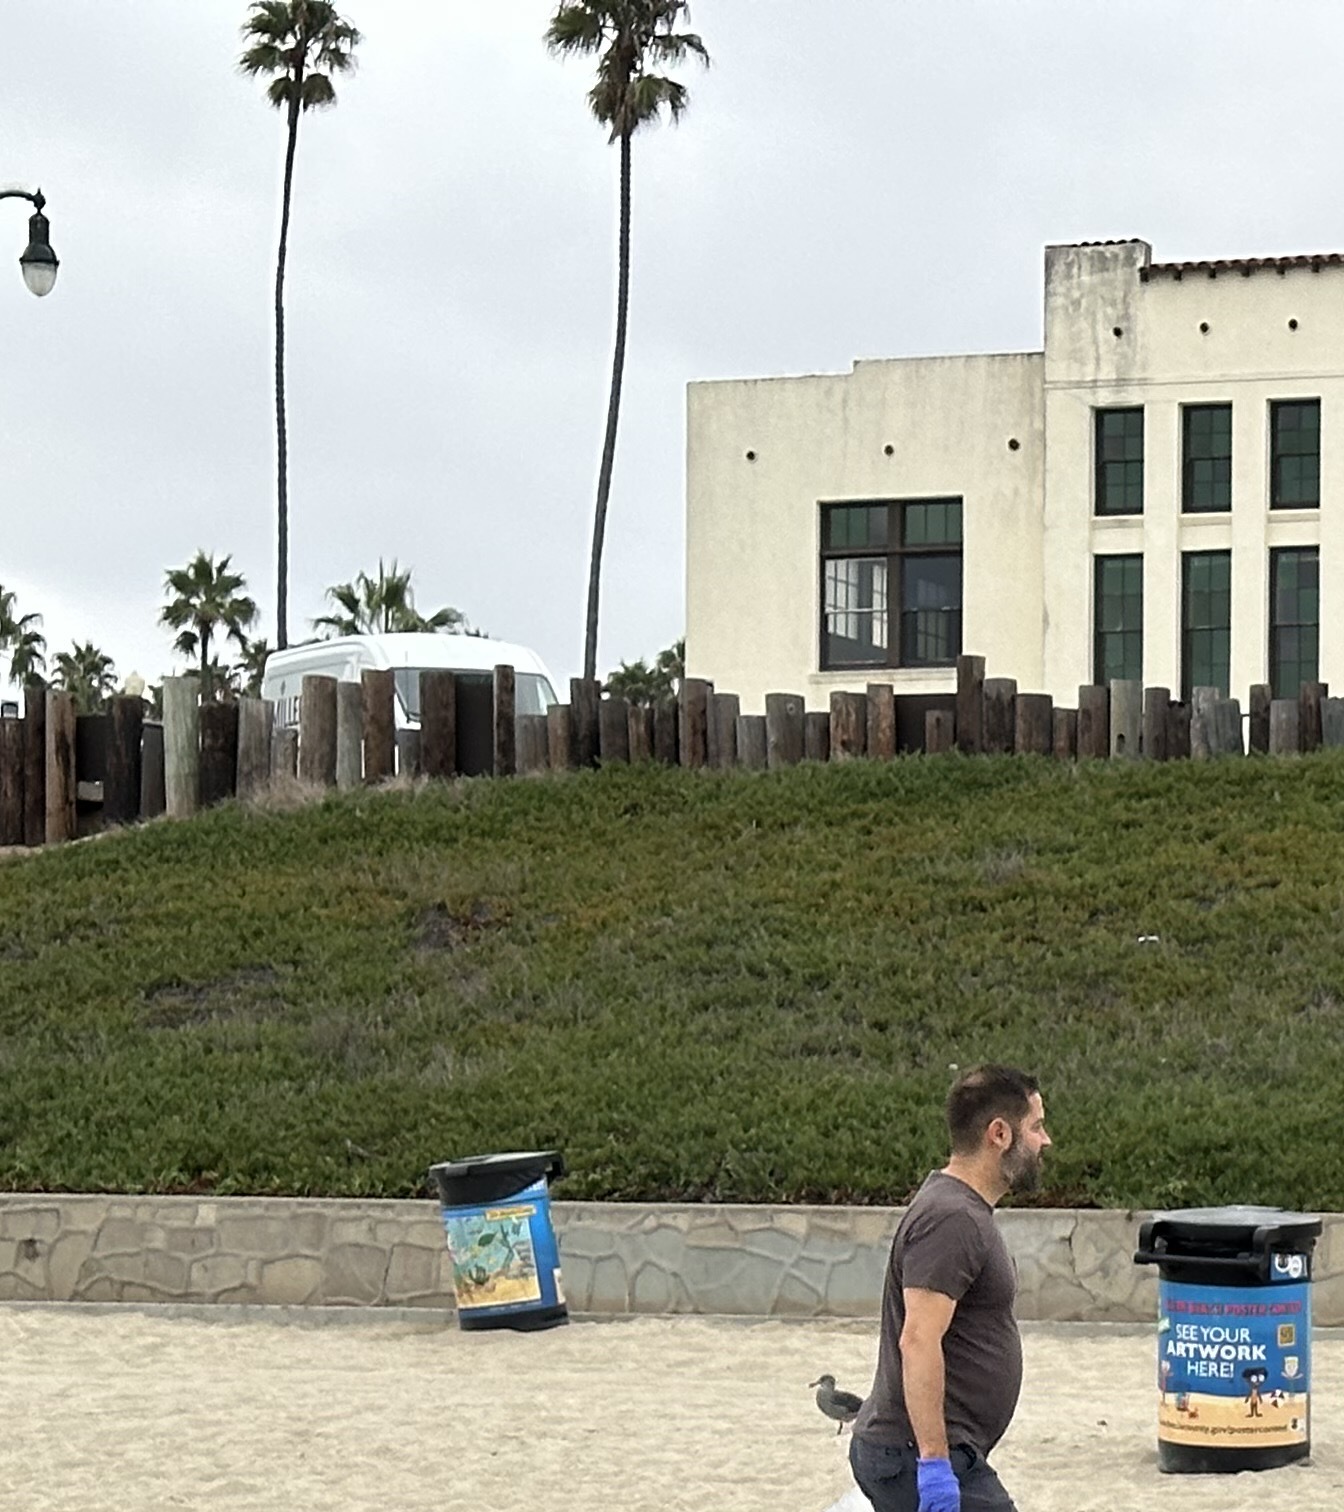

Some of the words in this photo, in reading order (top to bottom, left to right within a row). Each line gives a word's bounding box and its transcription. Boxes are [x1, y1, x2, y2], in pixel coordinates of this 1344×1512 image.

[1176, 1323, 1198, 1340] SEE
[1200, 1326, 1252, 1343] YOUR
[1166, 1340, 1267, 1361] ARTWORK
[1187, 1361, 1235, 1378] HERE!
